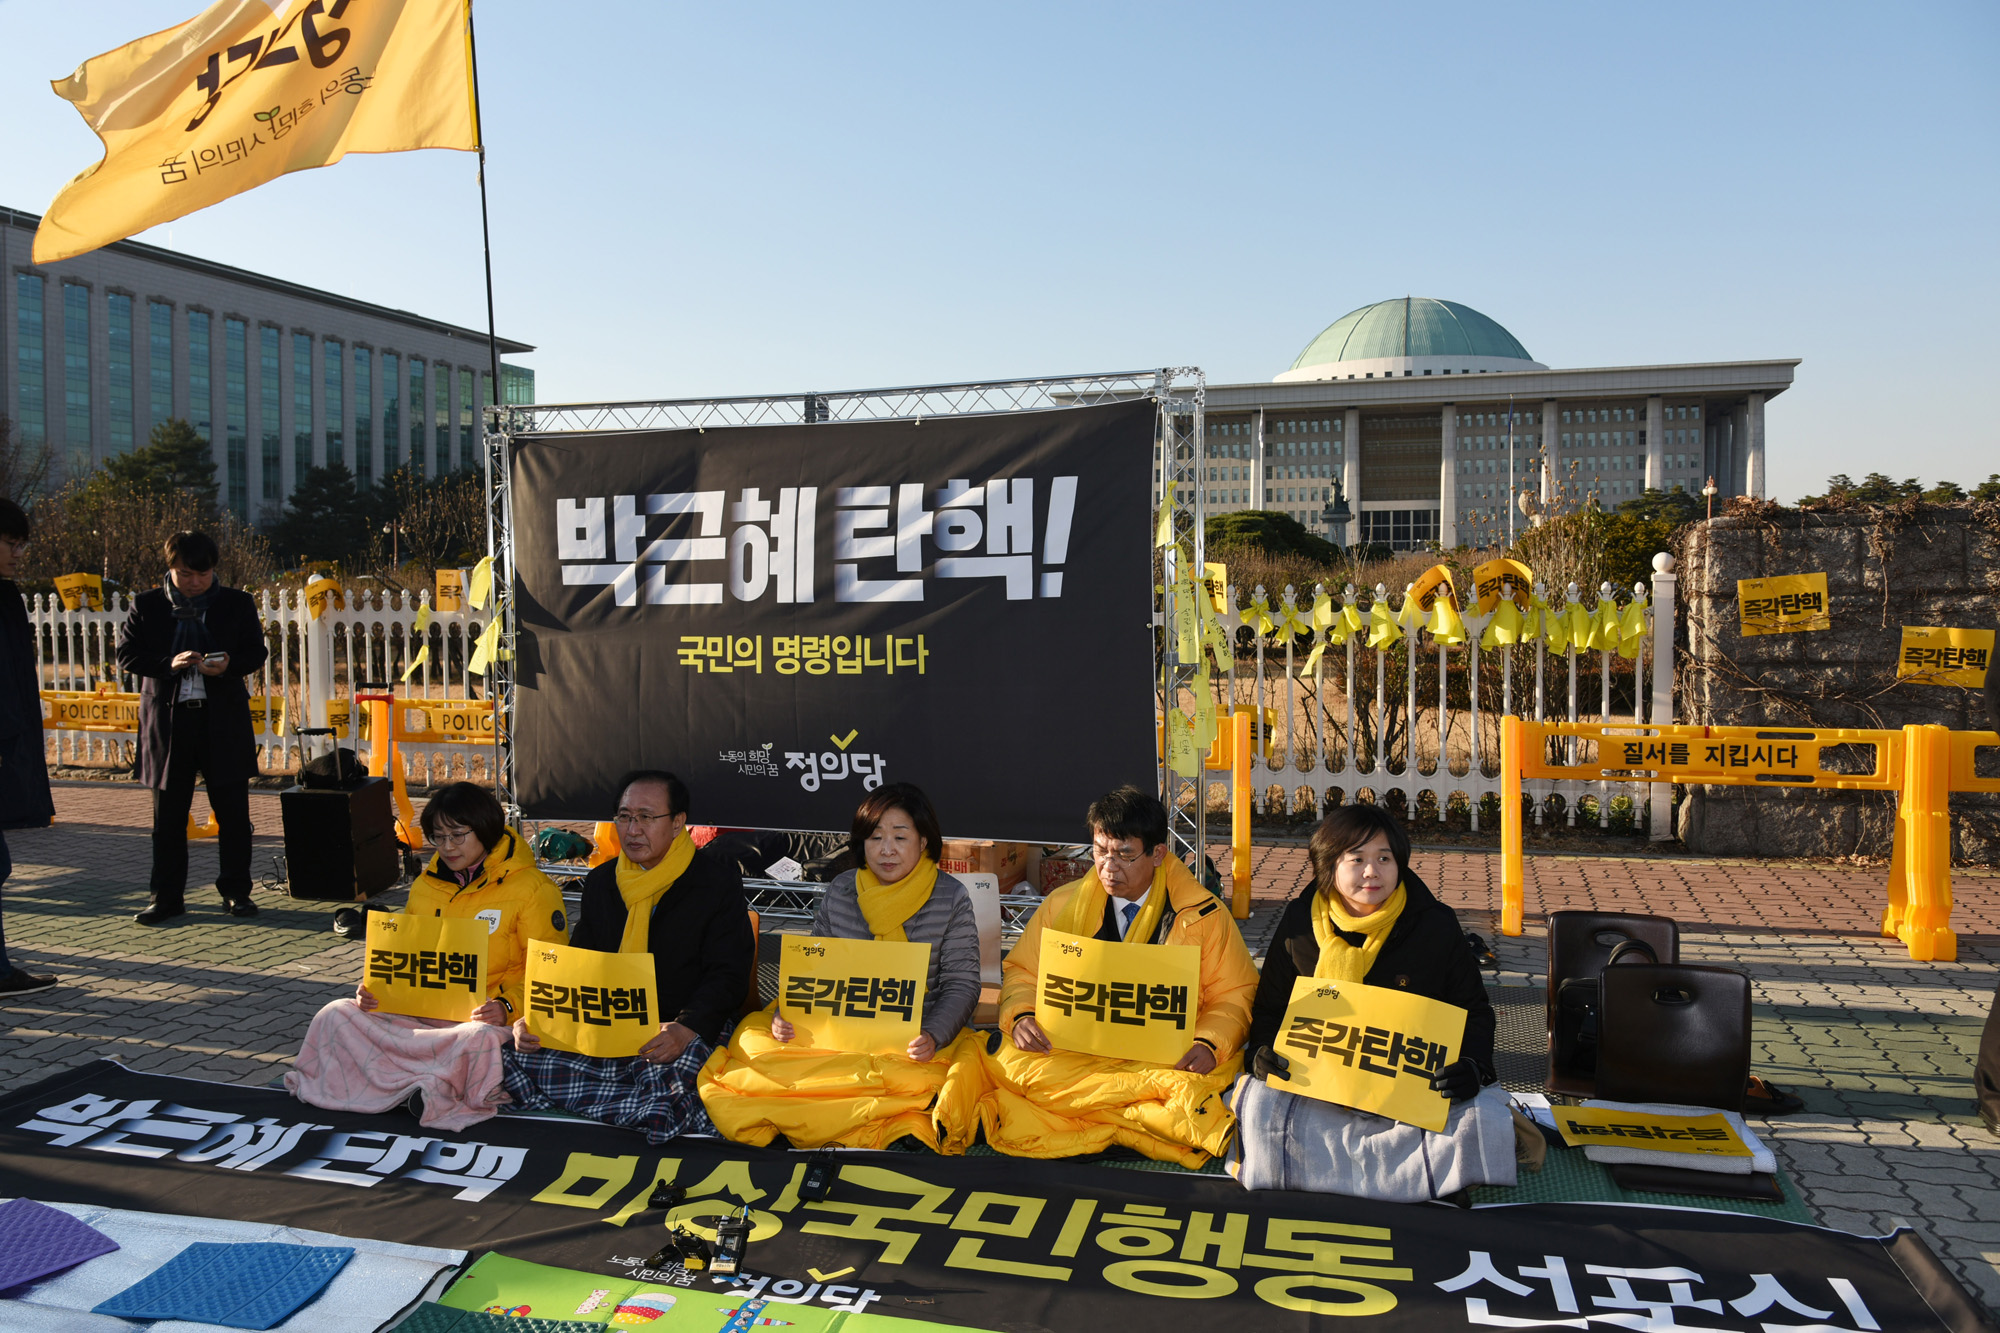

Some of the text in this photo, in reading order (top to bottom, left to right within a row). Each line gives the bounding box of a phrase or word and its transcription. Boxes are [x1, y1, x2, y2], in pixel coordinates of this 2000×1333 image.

[557, 476, 1079, 607] 박근혜 탄핵!
[1744, 592, 1822, 617] 즉각탄핵
[677, 634, 929, 675] 국민의 명령입니다
[1904, 647, 1988, 671] 즉각탄핵
[60, 704, 109, 720] POLICE
[443, 713, 497, 732] POLIC
[719, 749, 770, 764] 노동의 희망
[1623, 742, 1798, 769] 질서를 지킵시다
[738, 763, 779, 777] 시민의 꿈
[784, 751, 887, 793] 정의당
[381, 921, 398, 932] 정의당
[541, 951, 558, 964] 정의당
[803, 946, 826, 957] 정의당
[1060, 943, 1083, 957] 정의당
[370, 949, 478, 993] 즉각탄핵
[530, 980, 649, 1026] 즉각탄핵
[786, 976, 917, 1022] 즉각탄핵
[1044, 973, 1188, 1030] 즉각탄핵
[1316, 987, 1340, 1000] 정의당
[1285, 1016, 1448, 1092] 즉각탄핵
[16, 1093, 330, 1172] 박근혜
[282, 1130, 530, 1203] 탄핵
[625, 1268, 676, 1285] 시민의
